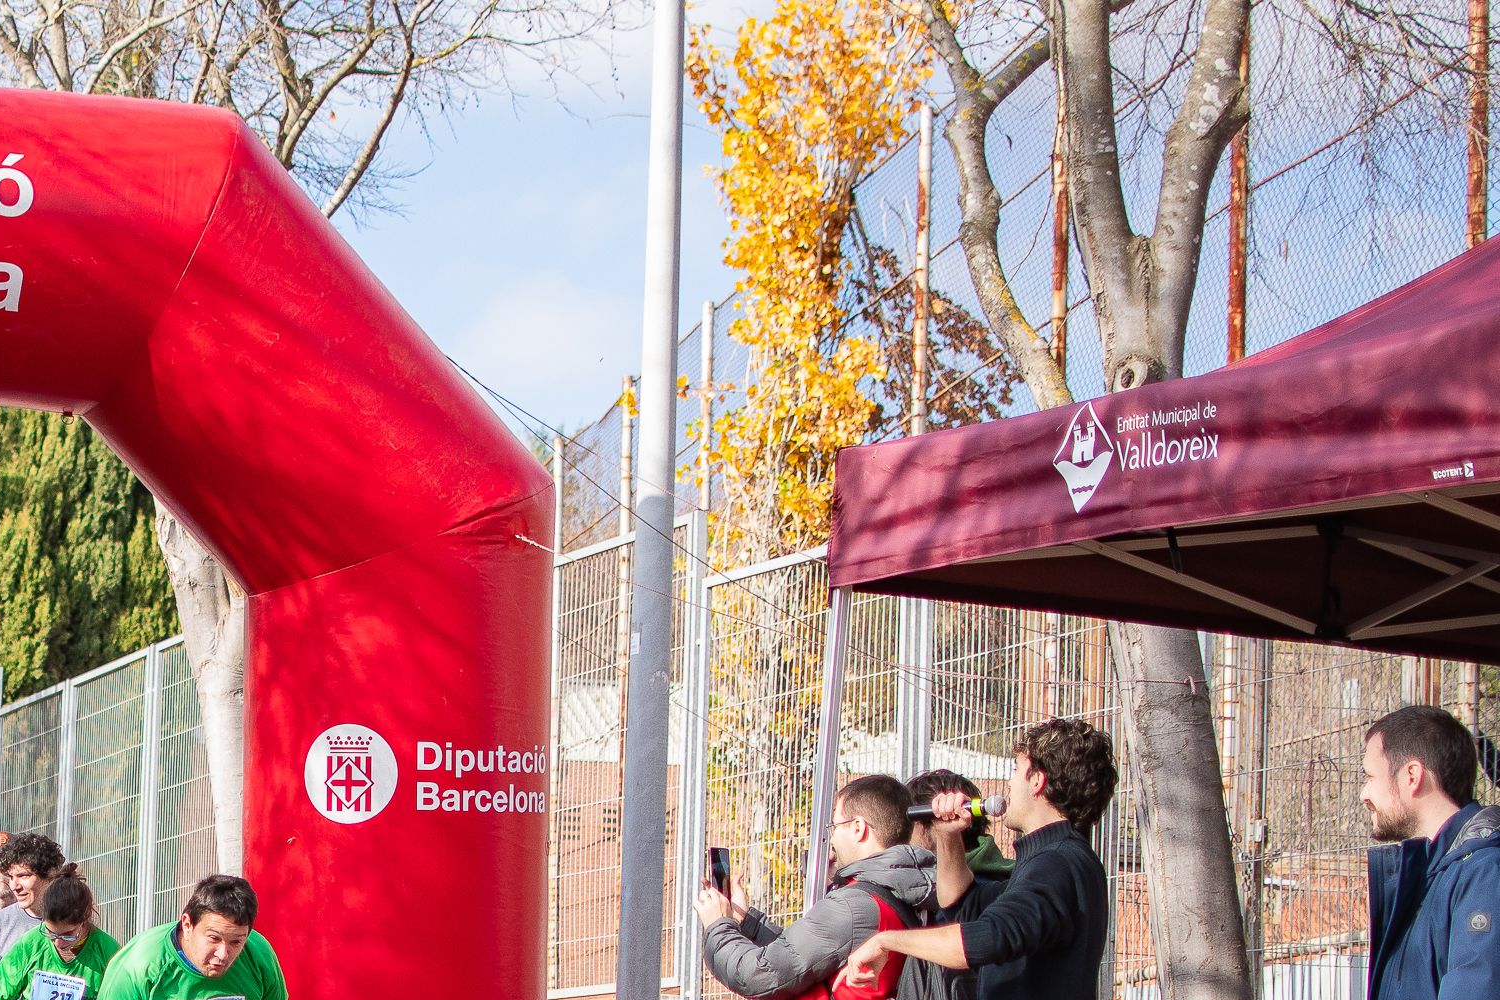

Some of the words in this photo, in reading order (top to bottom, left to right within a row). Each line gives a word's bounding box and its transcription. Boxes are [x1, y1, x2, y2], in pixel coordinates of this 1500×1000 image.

[1117, 413, 1149, 433] Entitat
[1151, 402, 1201, 427] Municipal
[1203, 400, 1217, 419] de
[1116, 427, 1219, 472] Valldoreix
[416, 741, 546, 778] Diputació
[416, 781, 546, 813] Barcelona
